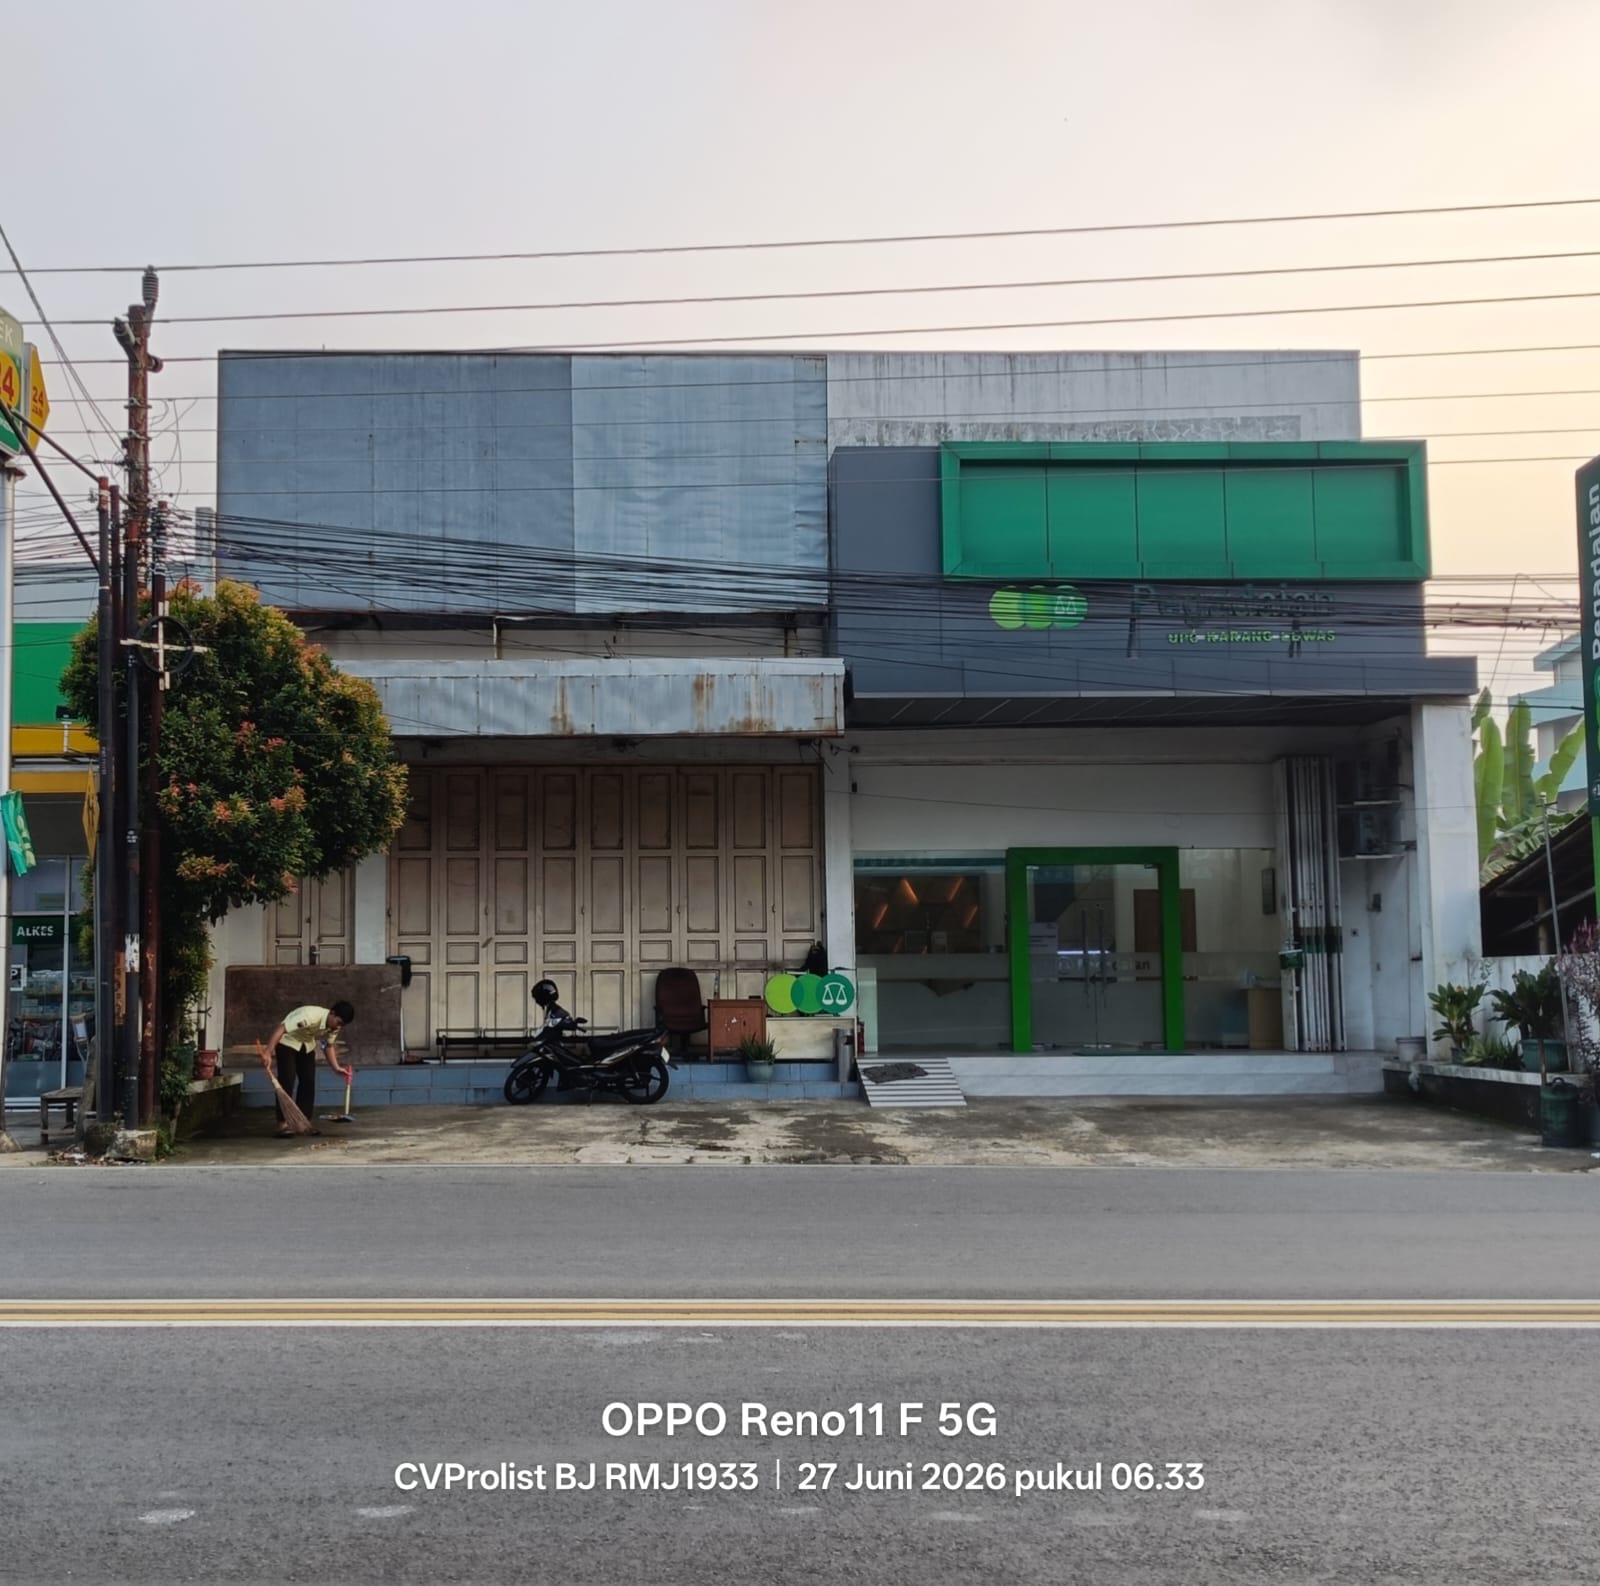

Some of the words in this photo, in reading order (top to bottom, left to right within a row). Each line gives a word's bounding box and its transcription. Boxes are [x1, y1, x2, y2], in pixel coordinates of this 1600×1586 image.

[0, 363, 15, 402] 4
[32, 385, 44, 408] 24
[16, 925, 54, 937] ALKES
